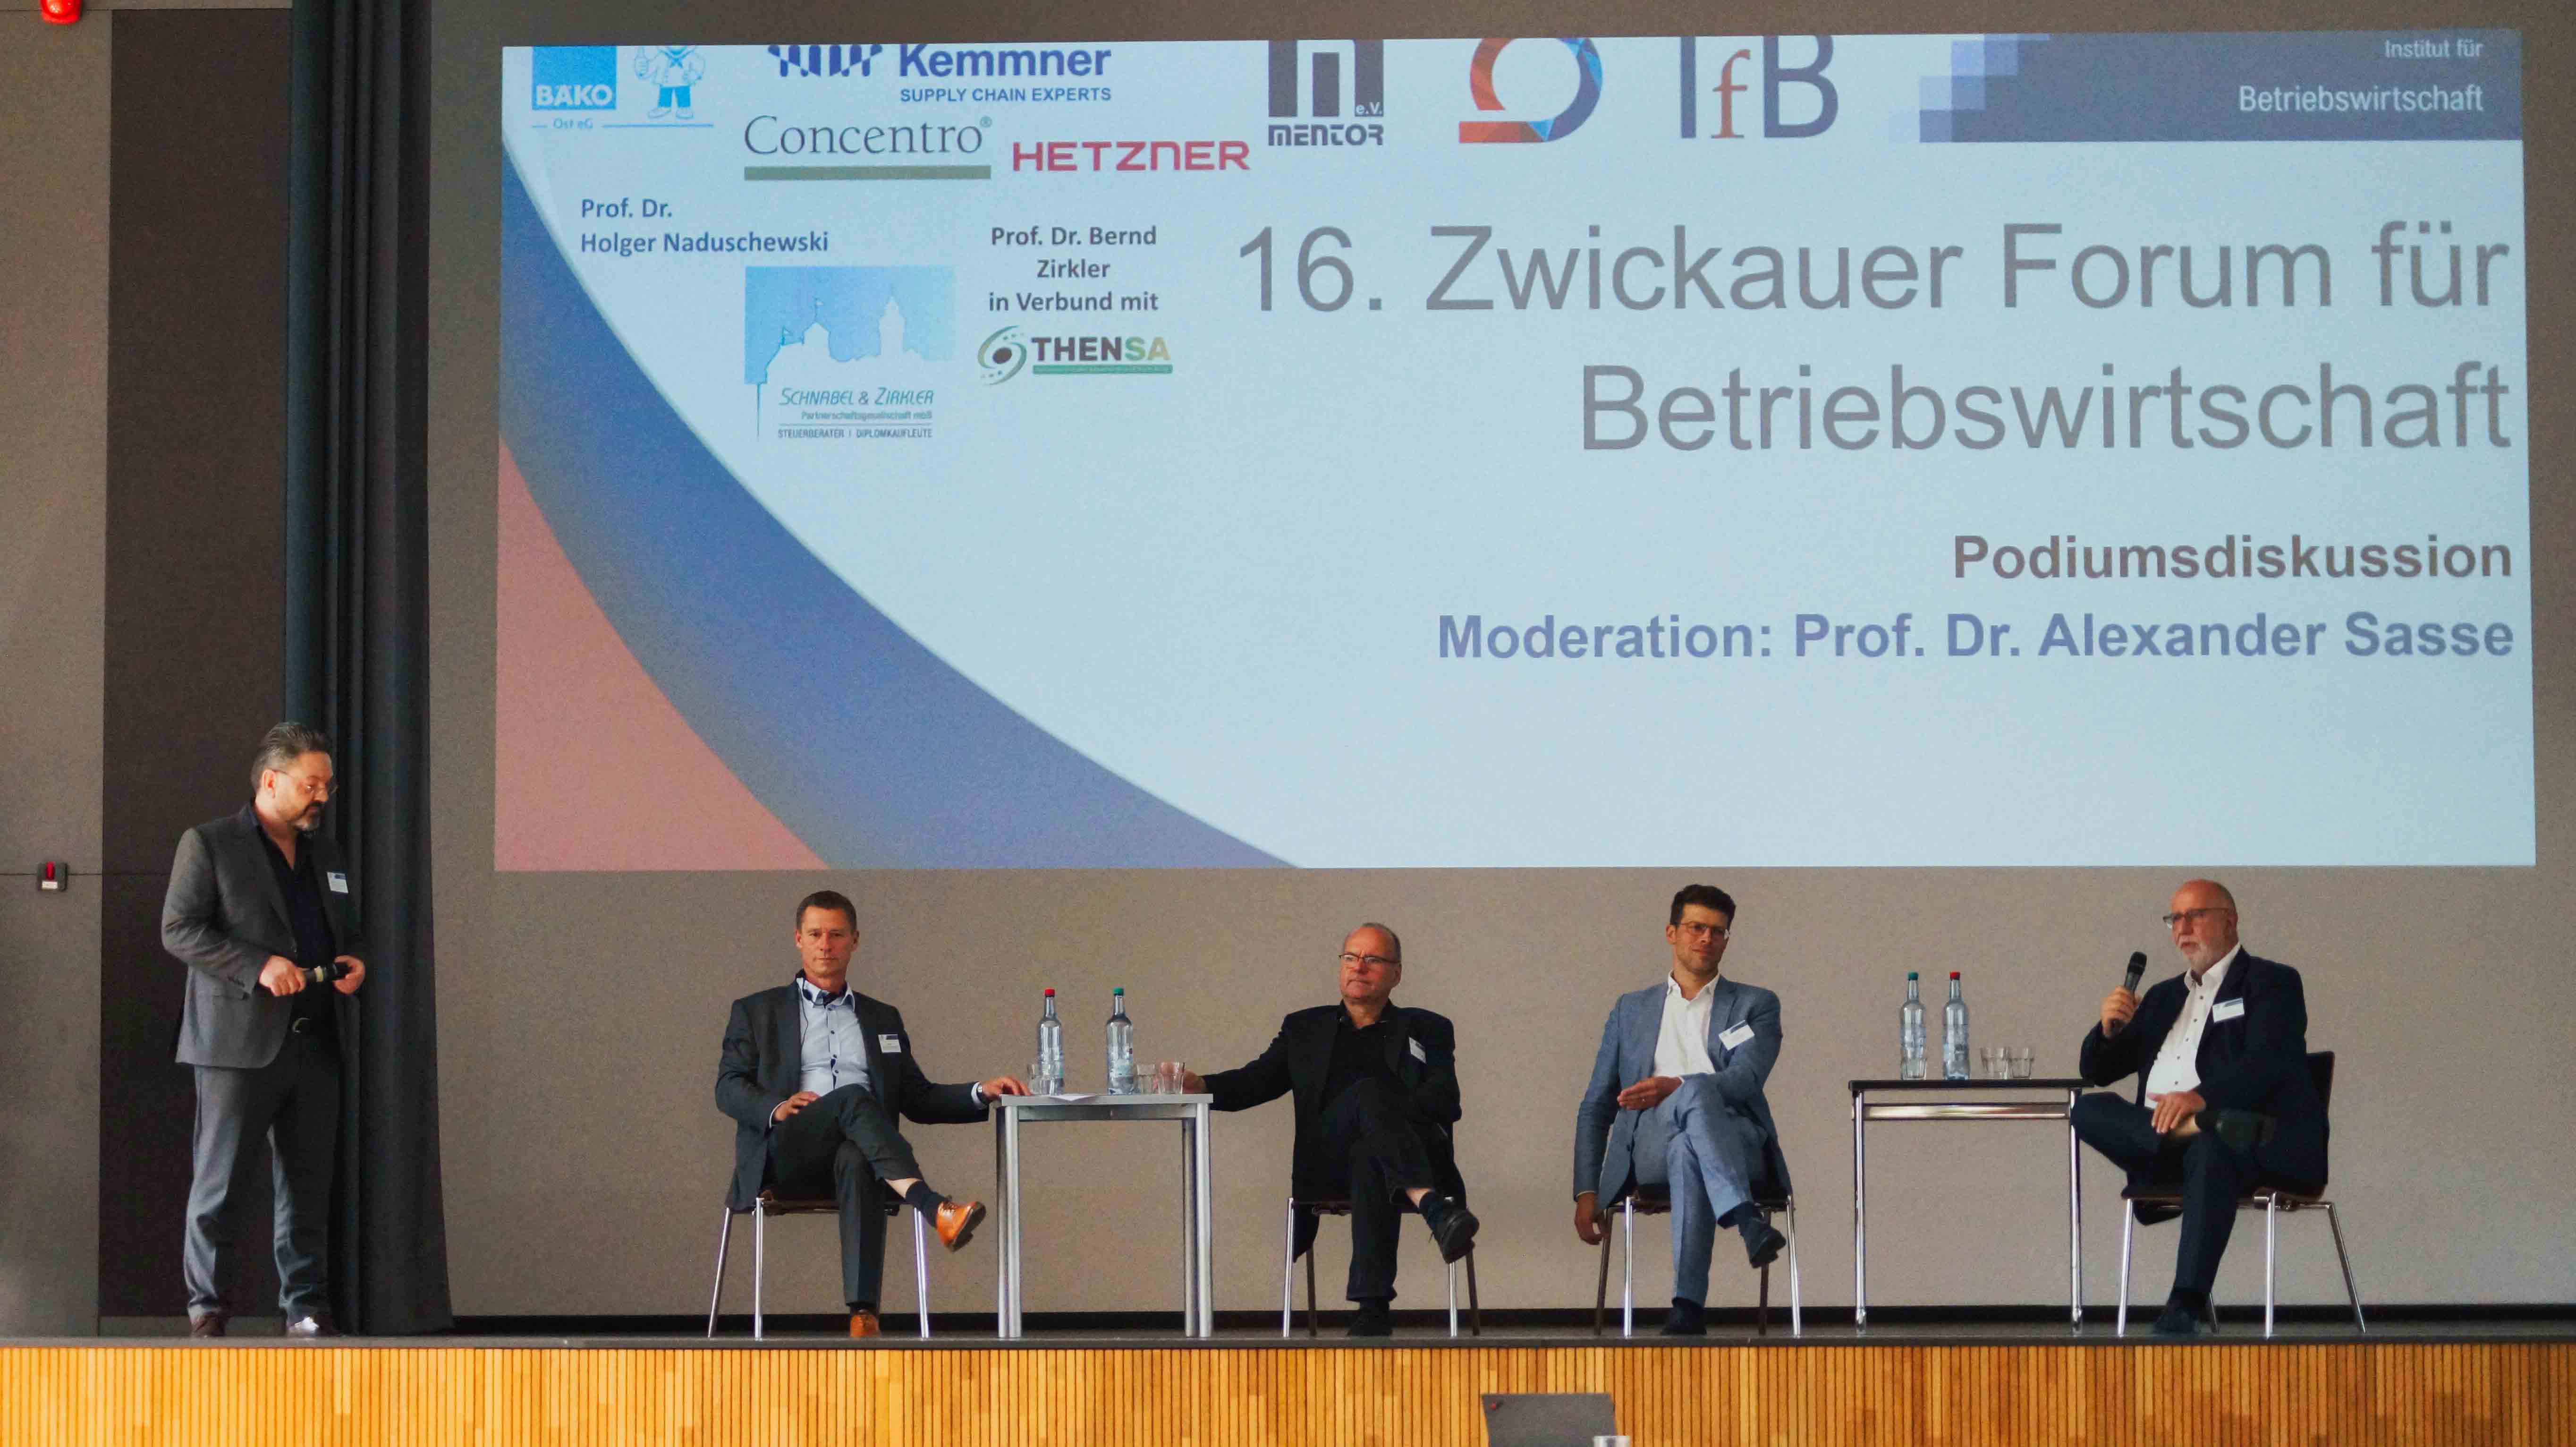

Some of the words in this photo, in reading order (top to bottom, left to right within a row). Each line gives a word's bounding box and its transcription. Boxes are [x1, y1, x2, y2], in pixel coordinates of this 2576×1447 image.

[899, 44, 1112, 77] Kemmner
[2384, 39, 2449, 58] Institut
[2457, 39, 2483, 58] für
[900, 88, 966, 102] SUPPLY
[972, 88, 1025, 102] CHAIN
[1032, 87, 1111, 102] EXPERTS
[1680, 35, 1839, 139] IfB
[2239, 84, 2483, 112] Betriebswirtschaft
[1012, 140, 1250, 171] HETZNER
[581, 197, 633, 218] Prof.
[642, 198, 672, 217] Dr.
[581, 232, 656, 256] Holger
[664, 230, 828, 252] Naduschewski
[992, 225, 1042, 246] Prof.
[1051, 227, 1081, 245] Dr.
[1090, 225, 1156, 245] Bernd
[1037, 258, 1110, 279] Zirkler
[1239, 226, 1382, 312] 16.
[1426, 224, 1965, 311] Zwickauer
[2003, 222, 2332, 309] Forum
[2371, 220, 2510, 307] für
[989, 292, 1008, 311] in
[1017, 291, 1112, 312] Verbund
[1121, 291, 1158, 311] mit
[1031, 336, 1171, 362] THENSA
[858, 391, 869, 405] &
[1583, 360, 2512, 451] Betriebswirtschaft
[1955, 534, 2512, 579] Podiumsdiskussion
[1439, 613, 1771, 659] Moderation:
[1795, 612, 1924, 657] Prof.
[1947, 613, 2020, 657] Dr.
[2037, 612, 2327, 657] Alexander
[2345, 611, 2514, 657] Sasse
